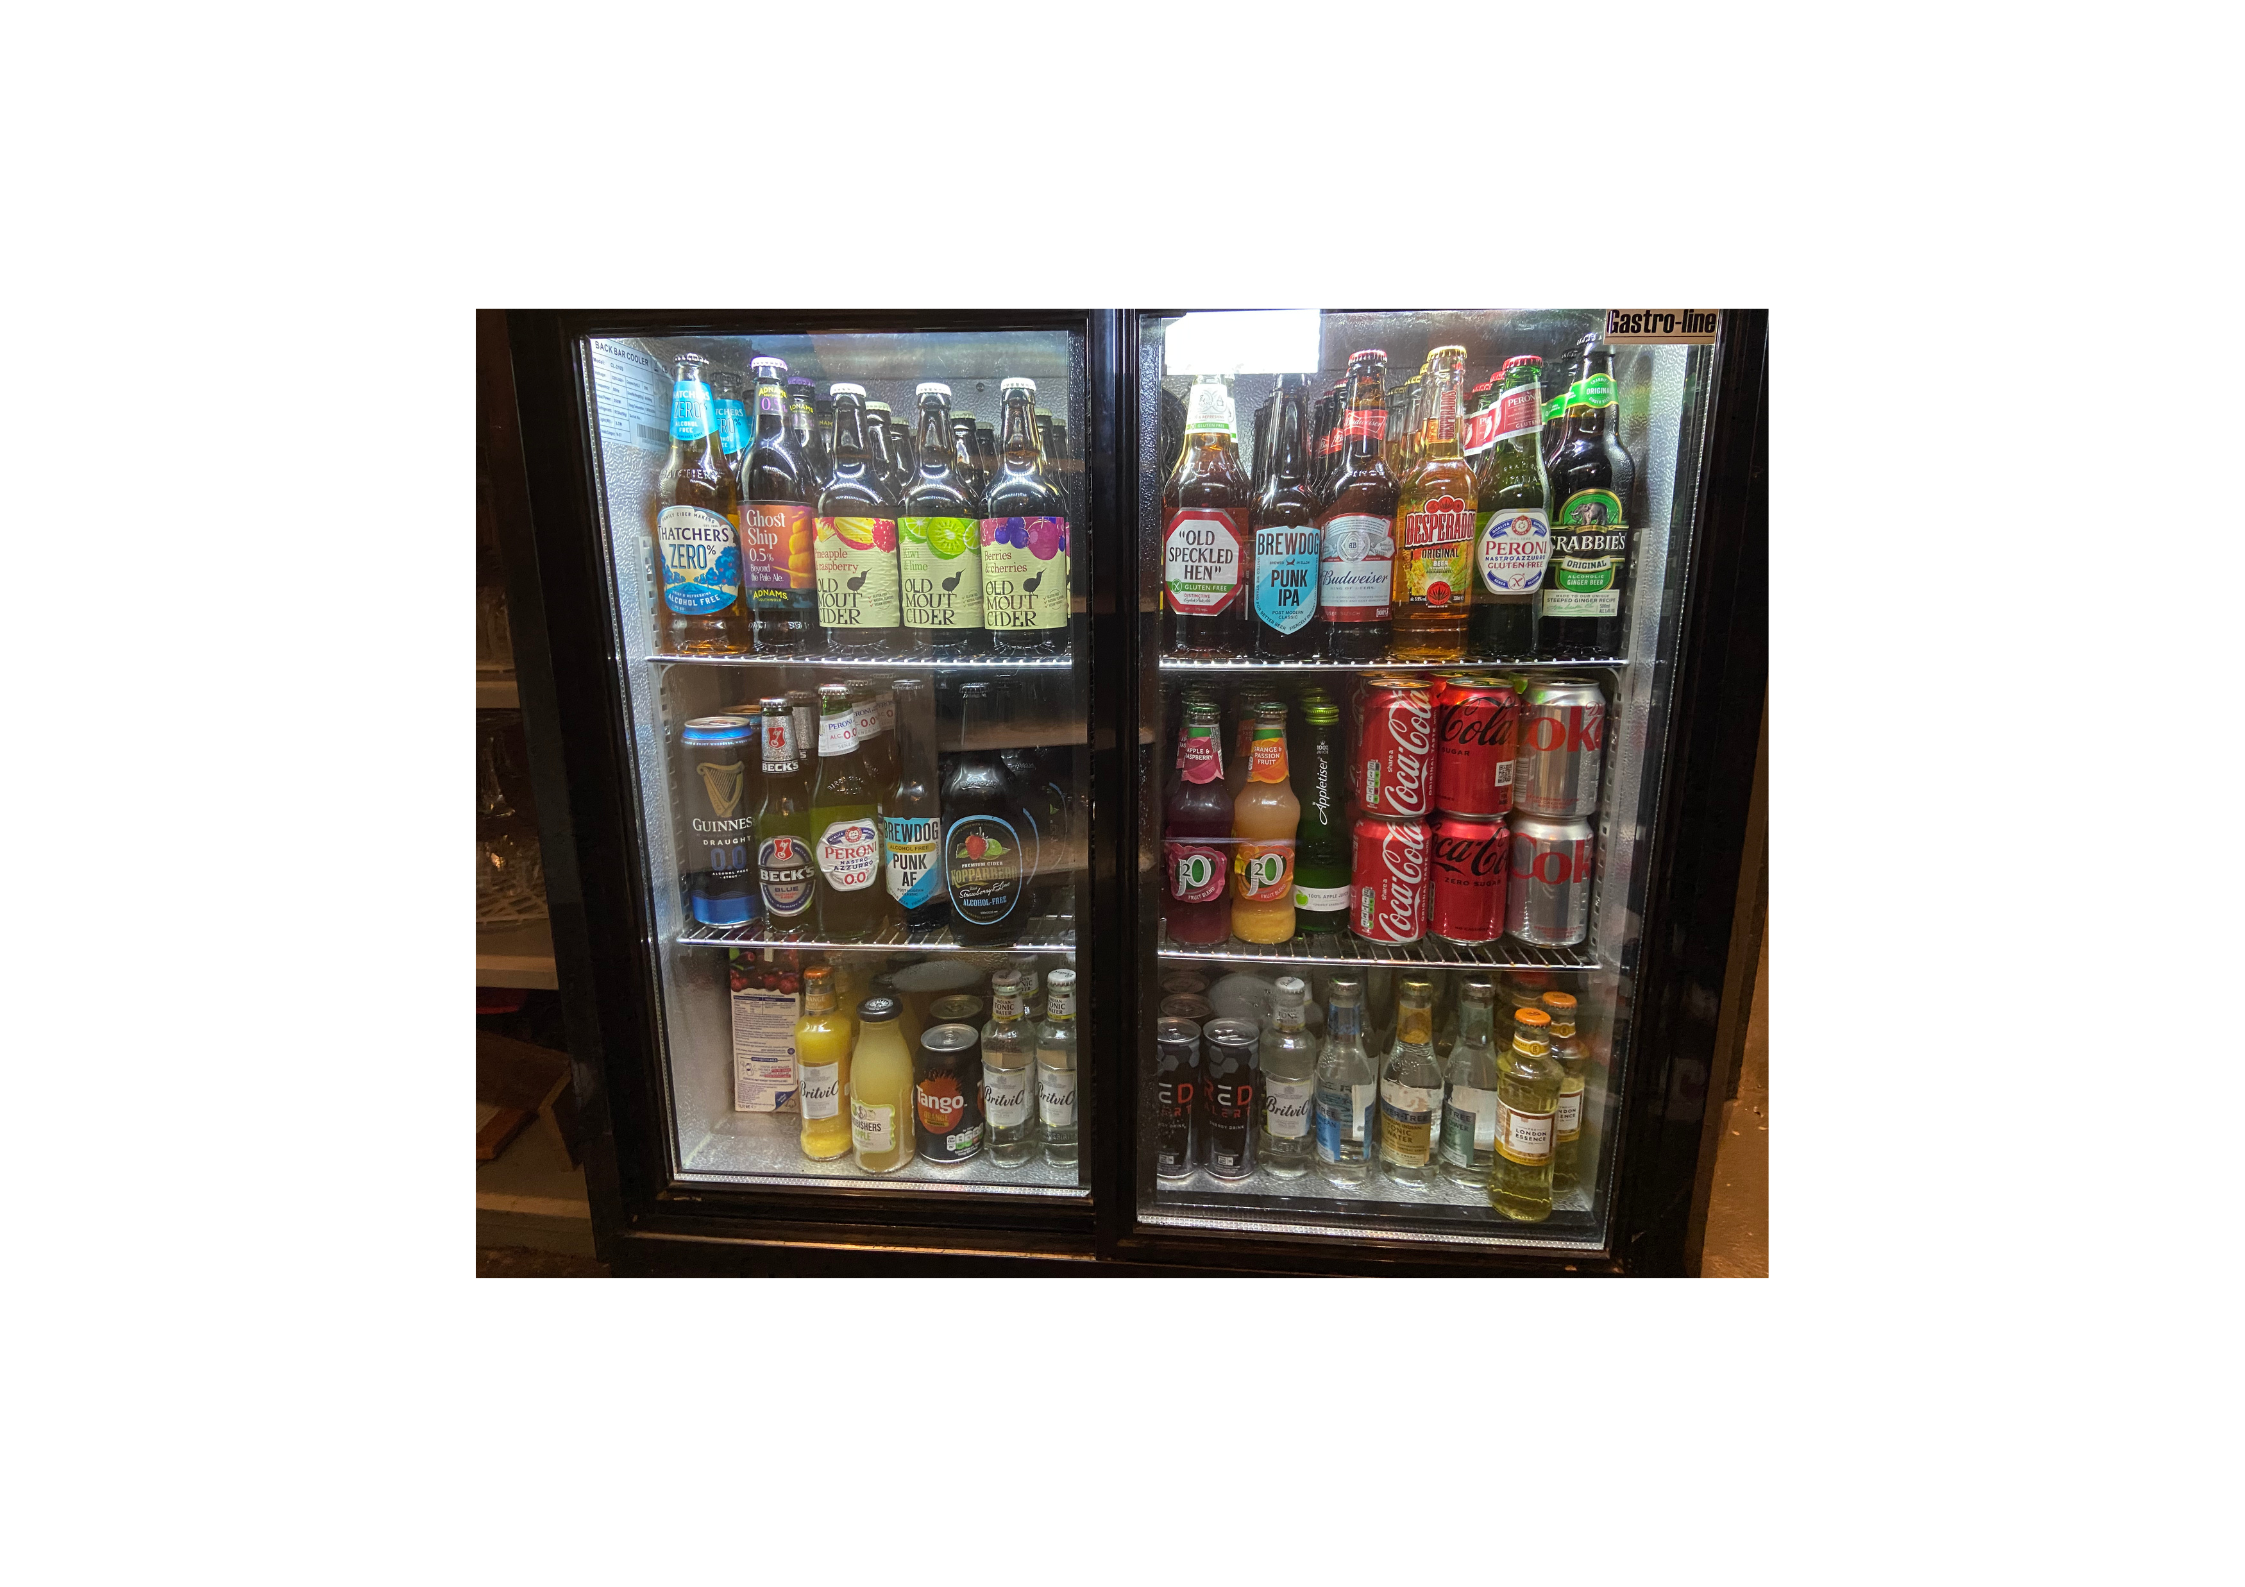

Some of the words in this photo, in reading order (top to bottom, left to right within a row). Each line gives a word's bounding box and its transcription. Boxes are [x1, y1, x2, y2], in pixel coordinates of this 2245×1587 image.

[1607, 309, 1717, 334] Gastro-line
[614, 347, 626, 358] BAR
[626, 350, 649, 367] COOLER
[746, 510, 786, 528] Ghost
[658, 525, 729, 542] THATCHERS
[1405, 511, 1475, 546] DESPERADOS
[748, 528, 778, 549] Ship
[1257, 532, 1319, 556] BREWDOG
[1550, 532, 1626, 552] CRABBIE'S
[749, 548, 775, 562] 0.5%
[984, 550, 1012, 560] Berries
[1168, 547, 1233, 564] SPECKLED
[1421, 548, 1459, 559] ORIGINAL
[1485, 541, 1547, 556] PERONI
[668, 544, 717, 570] ZERO%
[1567, 560, 1607, 569] ORIGINAL
[750, 564, 771, 573] Beyond
[909, 561, 928, 571] lime
[990, 562, 1028, 574] cherries
[759, 573, 772, 582] Pale
[1271, 569, 1308, 588] PUNK
[1322, 570, 1389, 586] Budweiser
[904, 578, 933, 593] OLD
[985, 580, 1014, 596] OLD
[668, 593, 698, 606] ALCOHOL
[700, 594, 721, 606] FREE
[818, 593, 863, 608] MOUT
[905, 593, 958, 608] MOUT
[987, 594, 1039, 611] MOUT
[1278, 589, 1300, 607] IPA
[906, 609, 957, 625] CIDER
[987, 610, 1039, 627] CIDER
[828, 719, 853, 731] PERONI
[861, 716, 876, 728] 0.0
[1385, 690, 1432, 815] Coca-Cola
[1441, 746, 1470, 756] SUGAR
[762, 761, 799, 772] BECK'S
[1312, 757, 1330, 826] Appletiser
[884, 821, 939, 842] BREWDOG
[703, 836, 752, 846] DRAUGHT
[825, 841, 877, 860] PERONI
[711, 845, 747, 872] 0.0
[834, 859, 873, 871] AZZURRO
[840, 857, 869, 865] NASTRO
[893, 853, 927, 870] PUNK
[760, 865, 815, 882] BECK'S
[902, 872, 917, 886] AF
[951, 866, 1017, 887] KOPPARBERG
[1379, 821, 1424, 942] Coca-Cola
[1444, 877, 1470, 886] ZERO
[963, 896, 1007, 907] ALCOHOL-FREE
[994, 1003, 1014, 1011] TONIC
[1204, 1076, 1253, 1106] RED
[1387, 1122, 1412, 1135] TONIC
[1515, 1128, 1547, 1136] LONDON
[1387, 1130, 1413, 1143] WATER
[1515, 1134, 1546, 1142] ESSENCE
